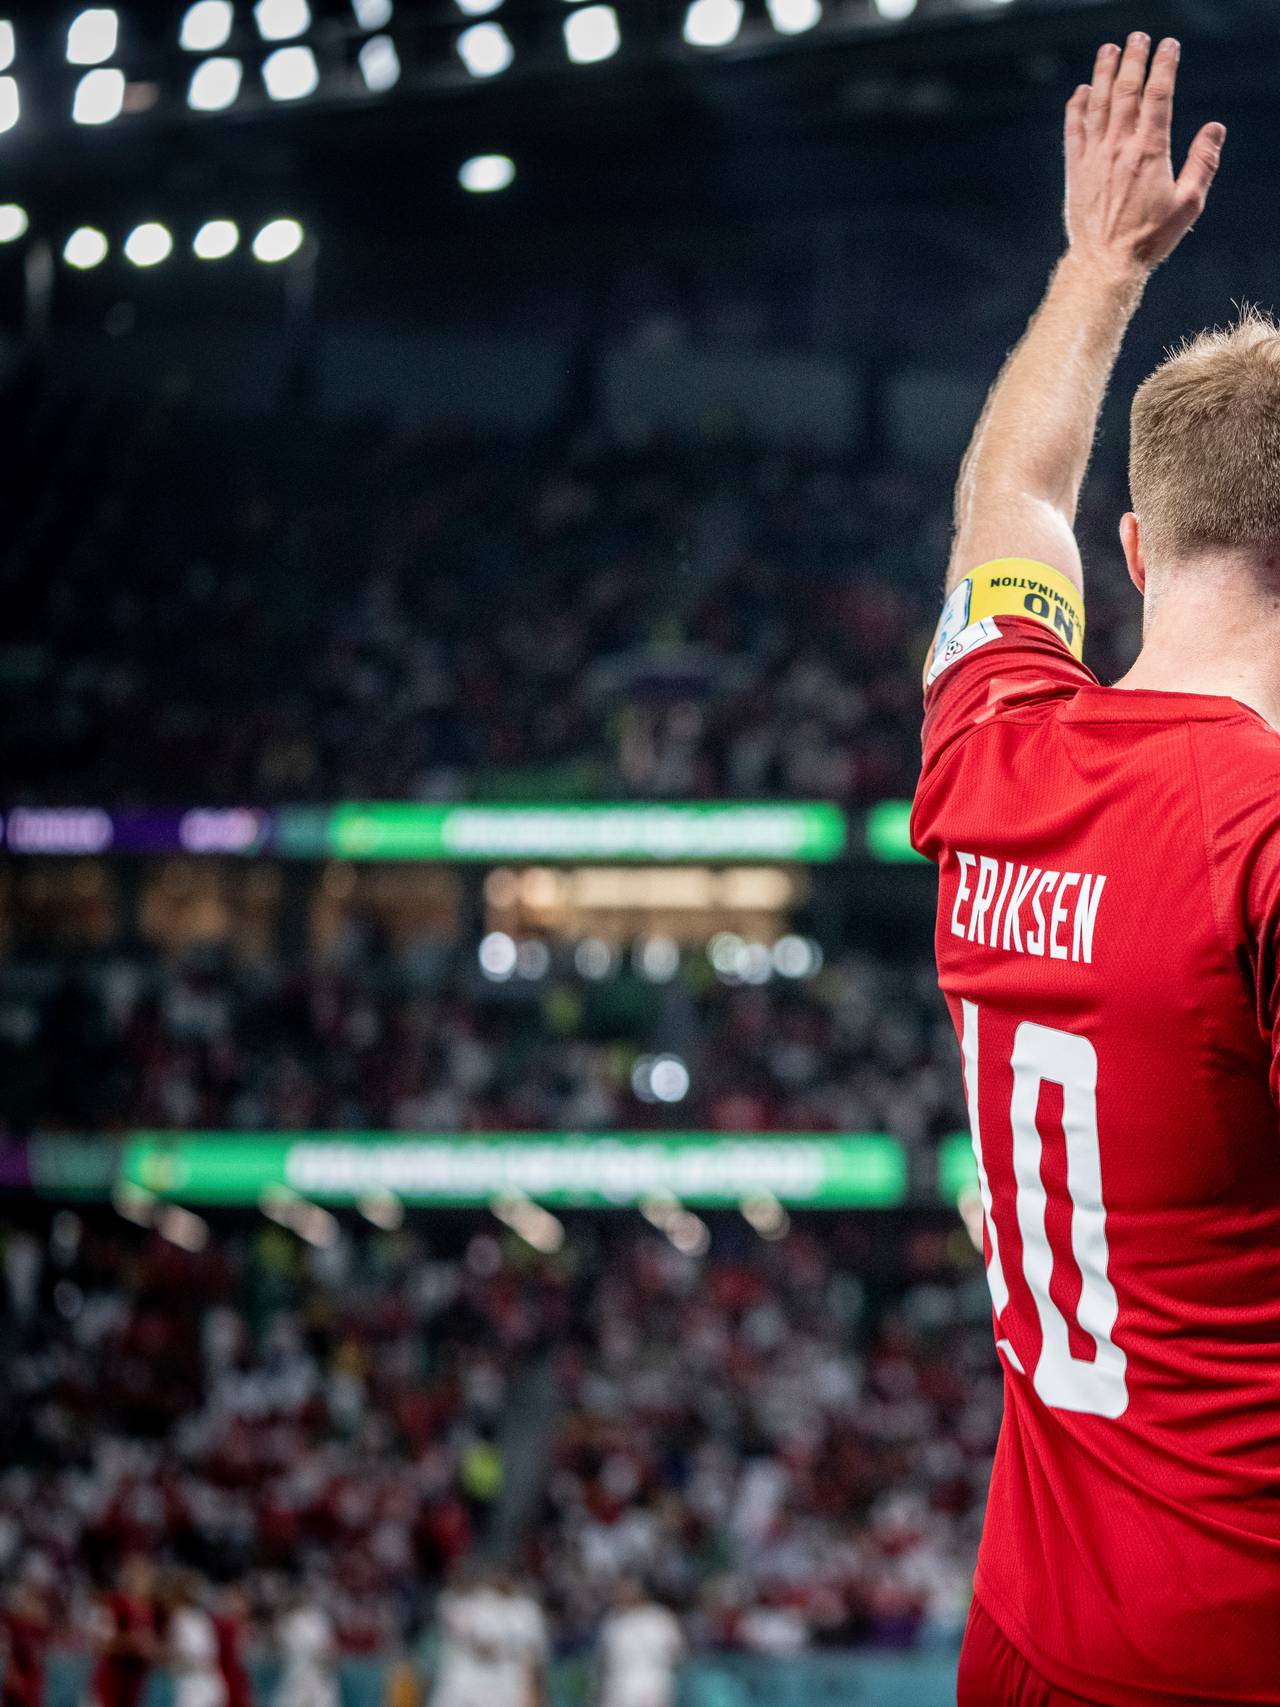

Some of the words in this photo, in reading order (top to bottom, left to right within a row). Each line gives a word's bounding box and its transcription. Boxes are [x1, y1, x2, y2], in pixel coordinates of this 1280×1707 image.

[1024, 593, 1074, 645] NO
[951, 851, 1107, 964] ERIKSEN
[961, 998, 1129, 1419] 10
